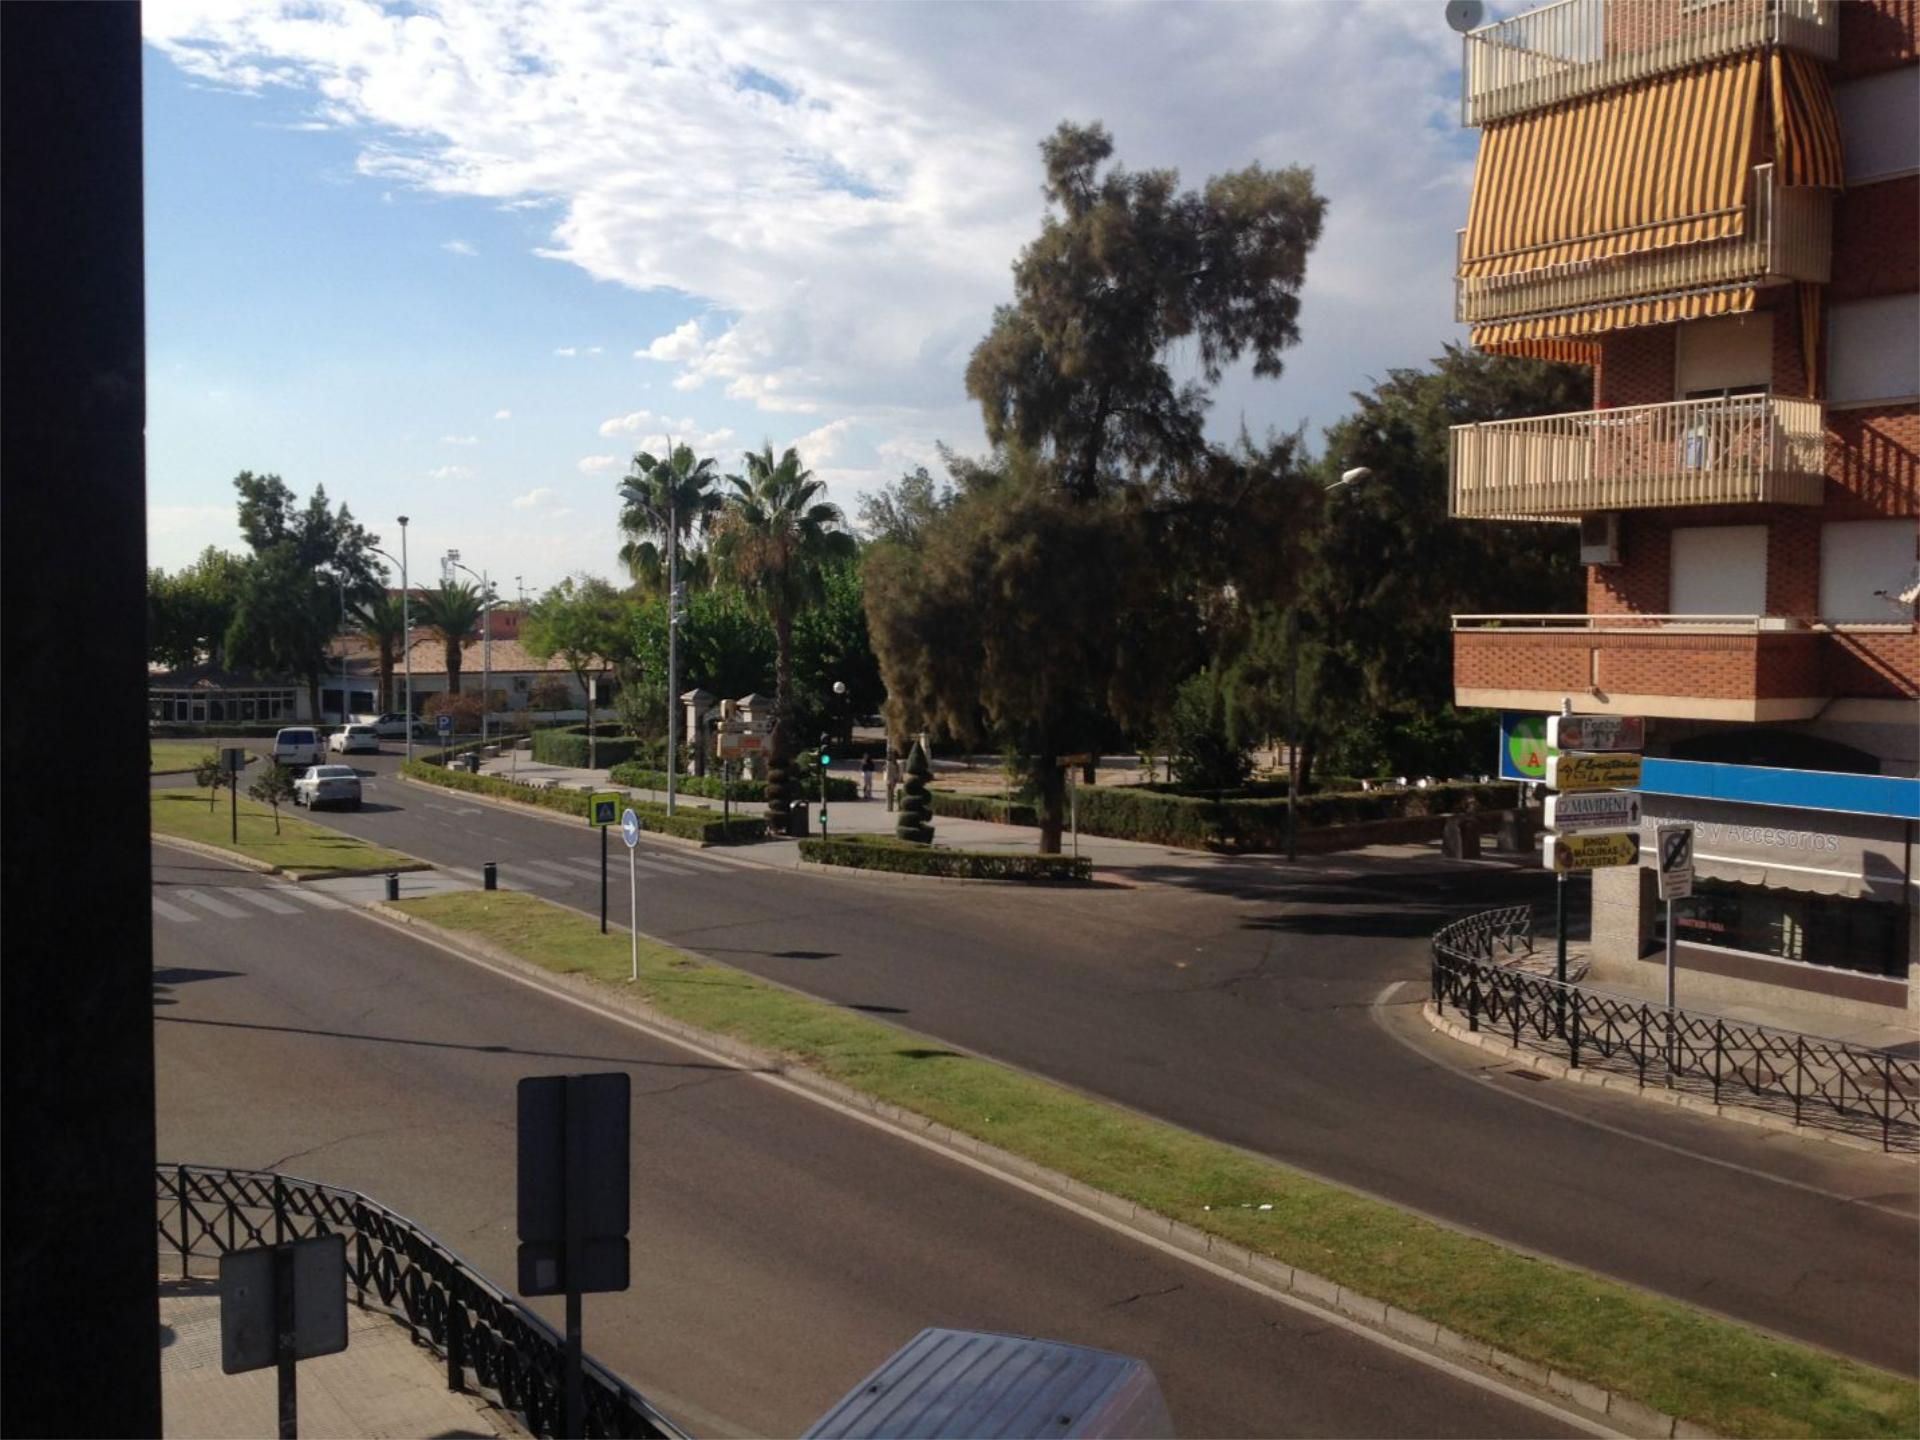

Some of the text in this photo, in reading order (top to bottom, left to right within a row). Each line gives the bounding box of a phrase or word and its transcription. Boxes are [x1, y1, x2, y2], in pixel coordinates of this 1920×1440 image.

[439, 716, 449, 729] P
[1571, 797, 1628, 813] MAVIDENT
[1727, 824, 1840, 853] Accesorios
